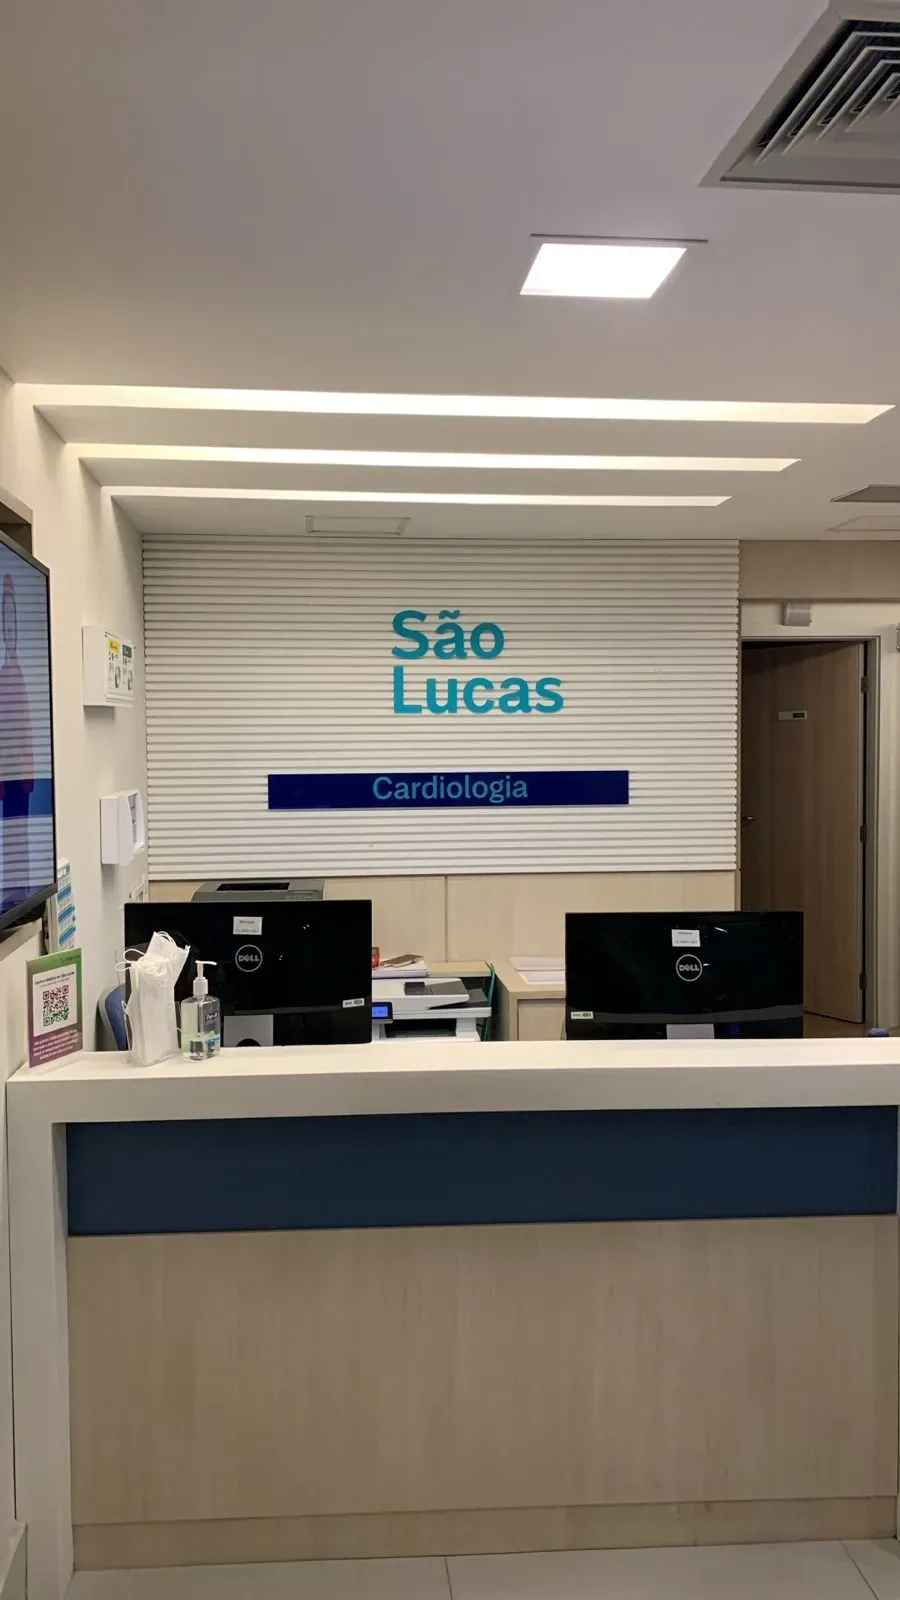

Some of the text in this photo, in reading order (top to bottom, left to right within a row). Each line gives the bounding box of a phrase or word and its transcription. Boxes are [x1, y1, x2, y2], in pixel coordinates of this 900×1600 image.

[391, 609, 505, 660] São
[393, 665, 565, 714] Lucas
[372, 775, 529, 804] Cardiologia
[238, 954, 260, 962] DELL
[679, 964, 700, 972] DELL
